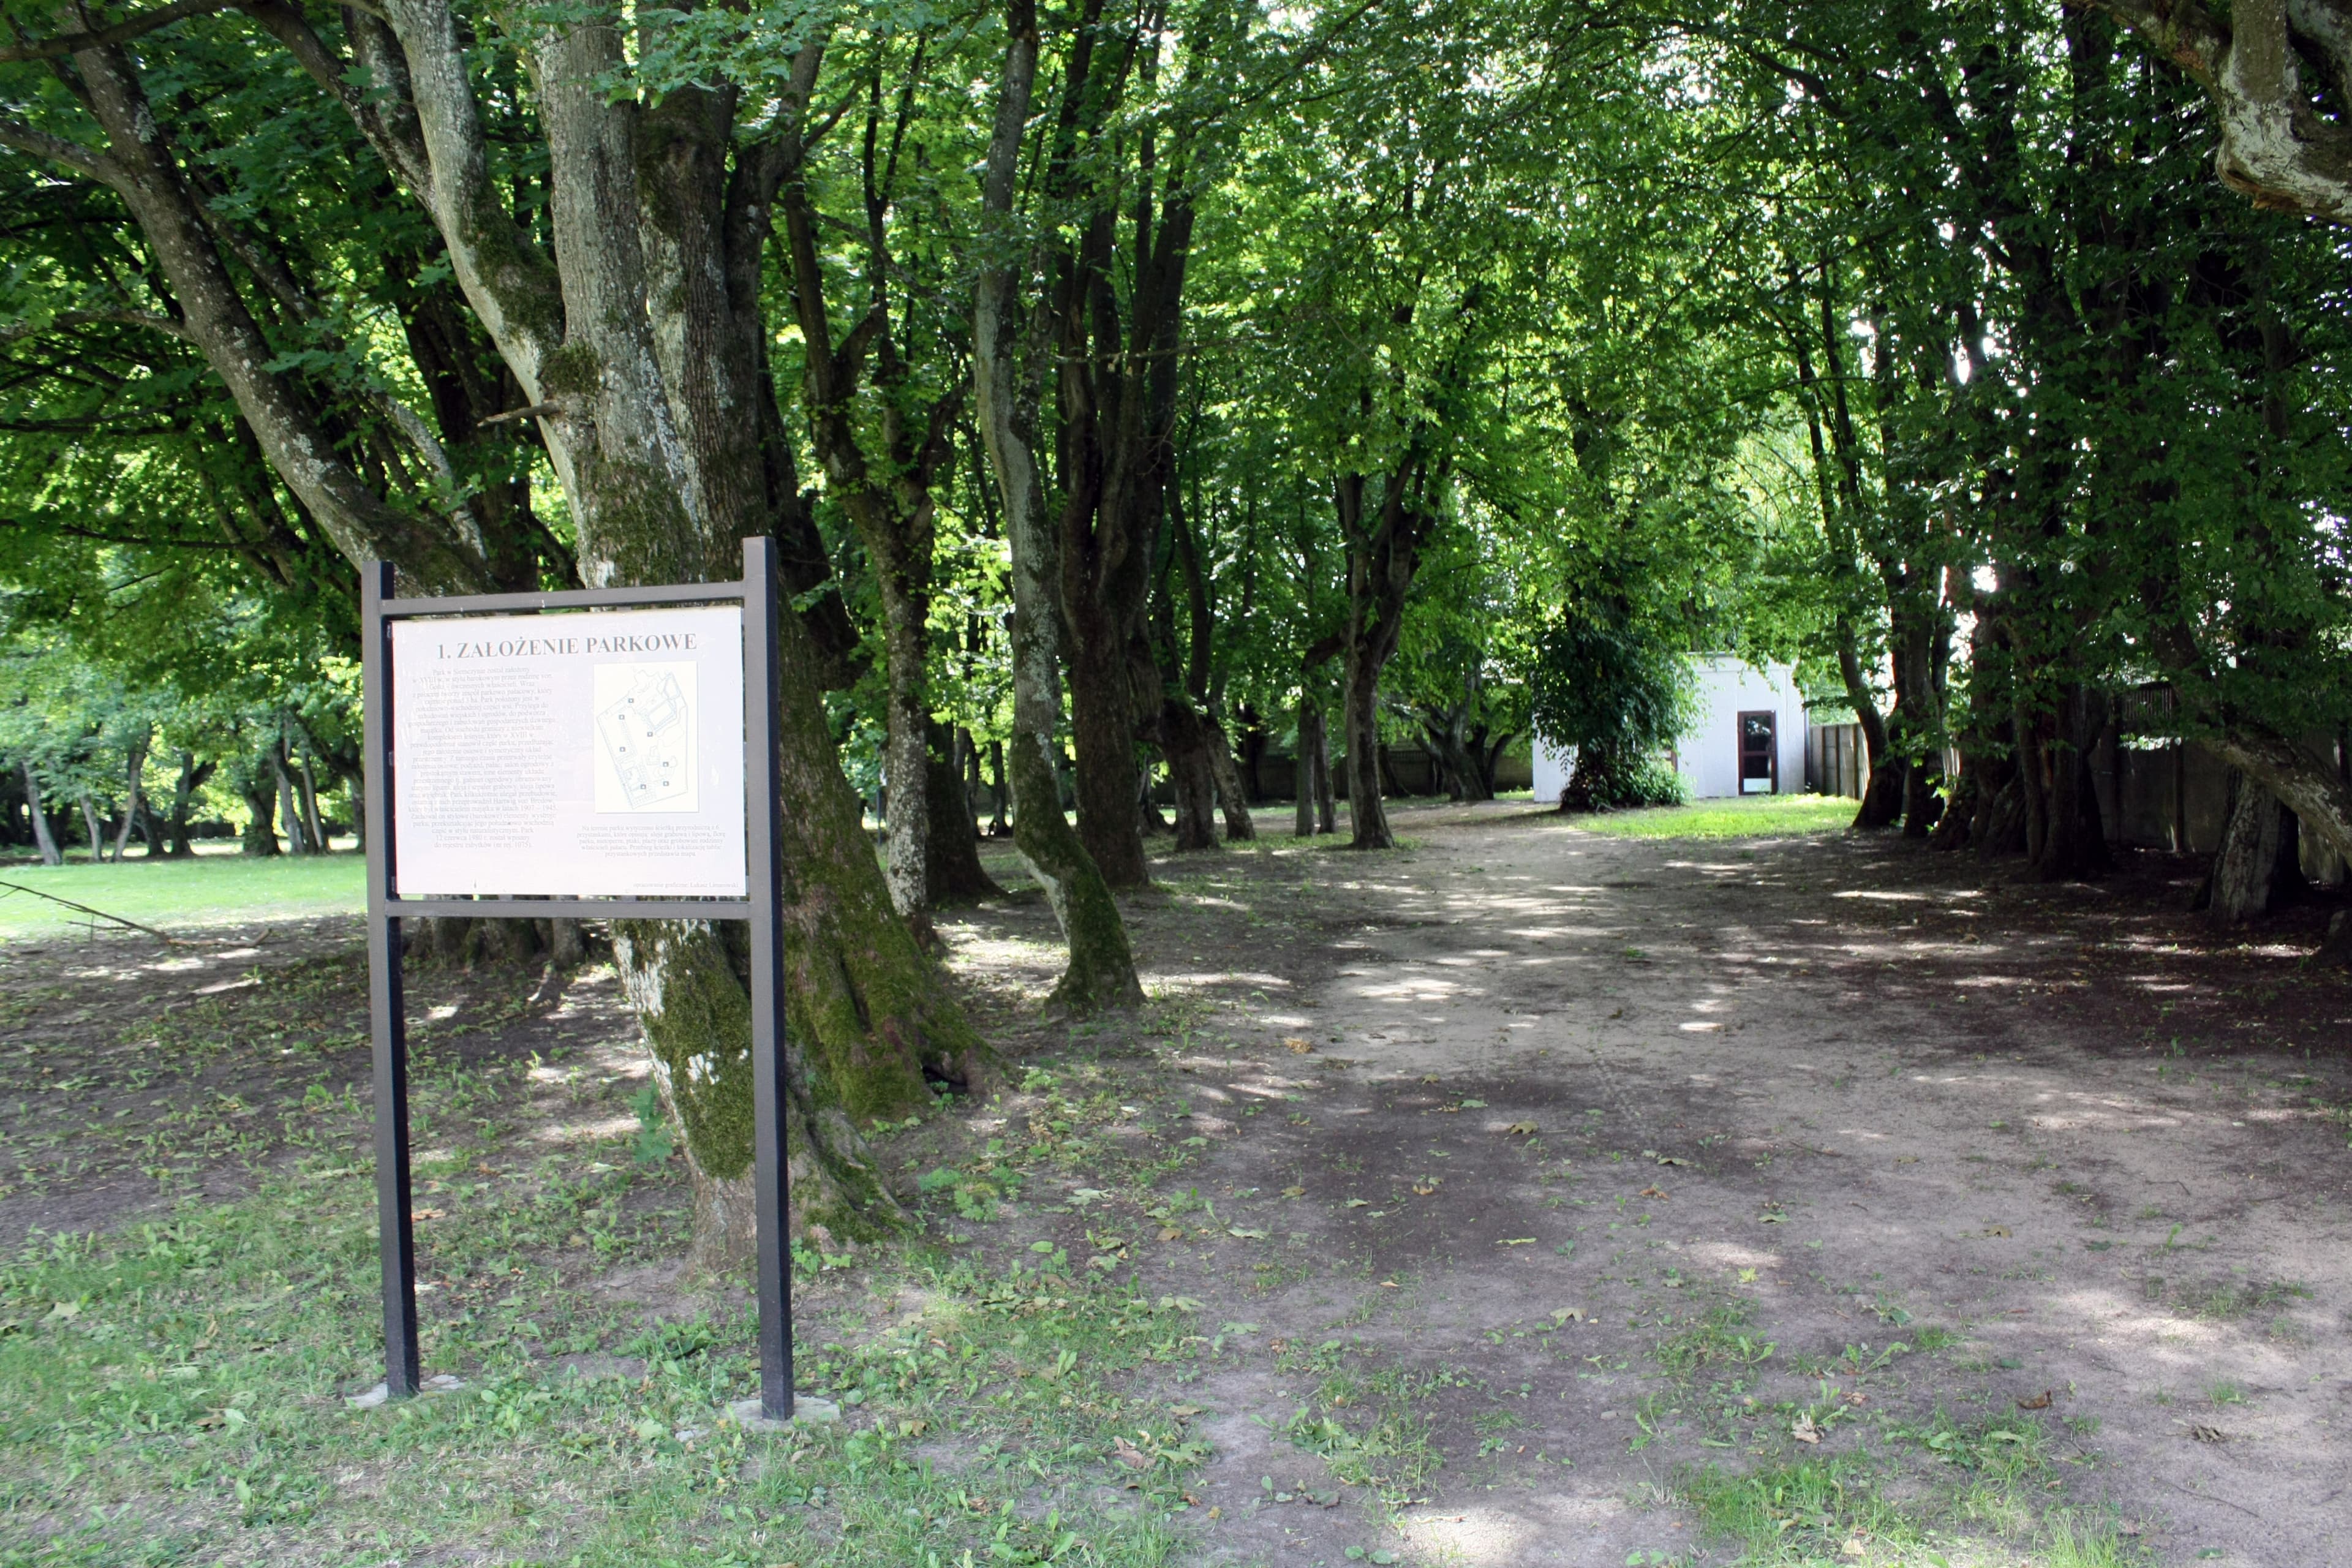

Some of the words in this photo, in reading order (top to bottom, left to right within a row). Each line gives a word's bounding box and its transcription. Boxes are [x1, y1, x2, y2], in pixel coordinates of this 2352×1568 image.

[437, 644, 451, 658] 1.
[457, 636, 579, 658] ZAŁOŻENIE
[586, 633, 697, 653] PARKOWE
